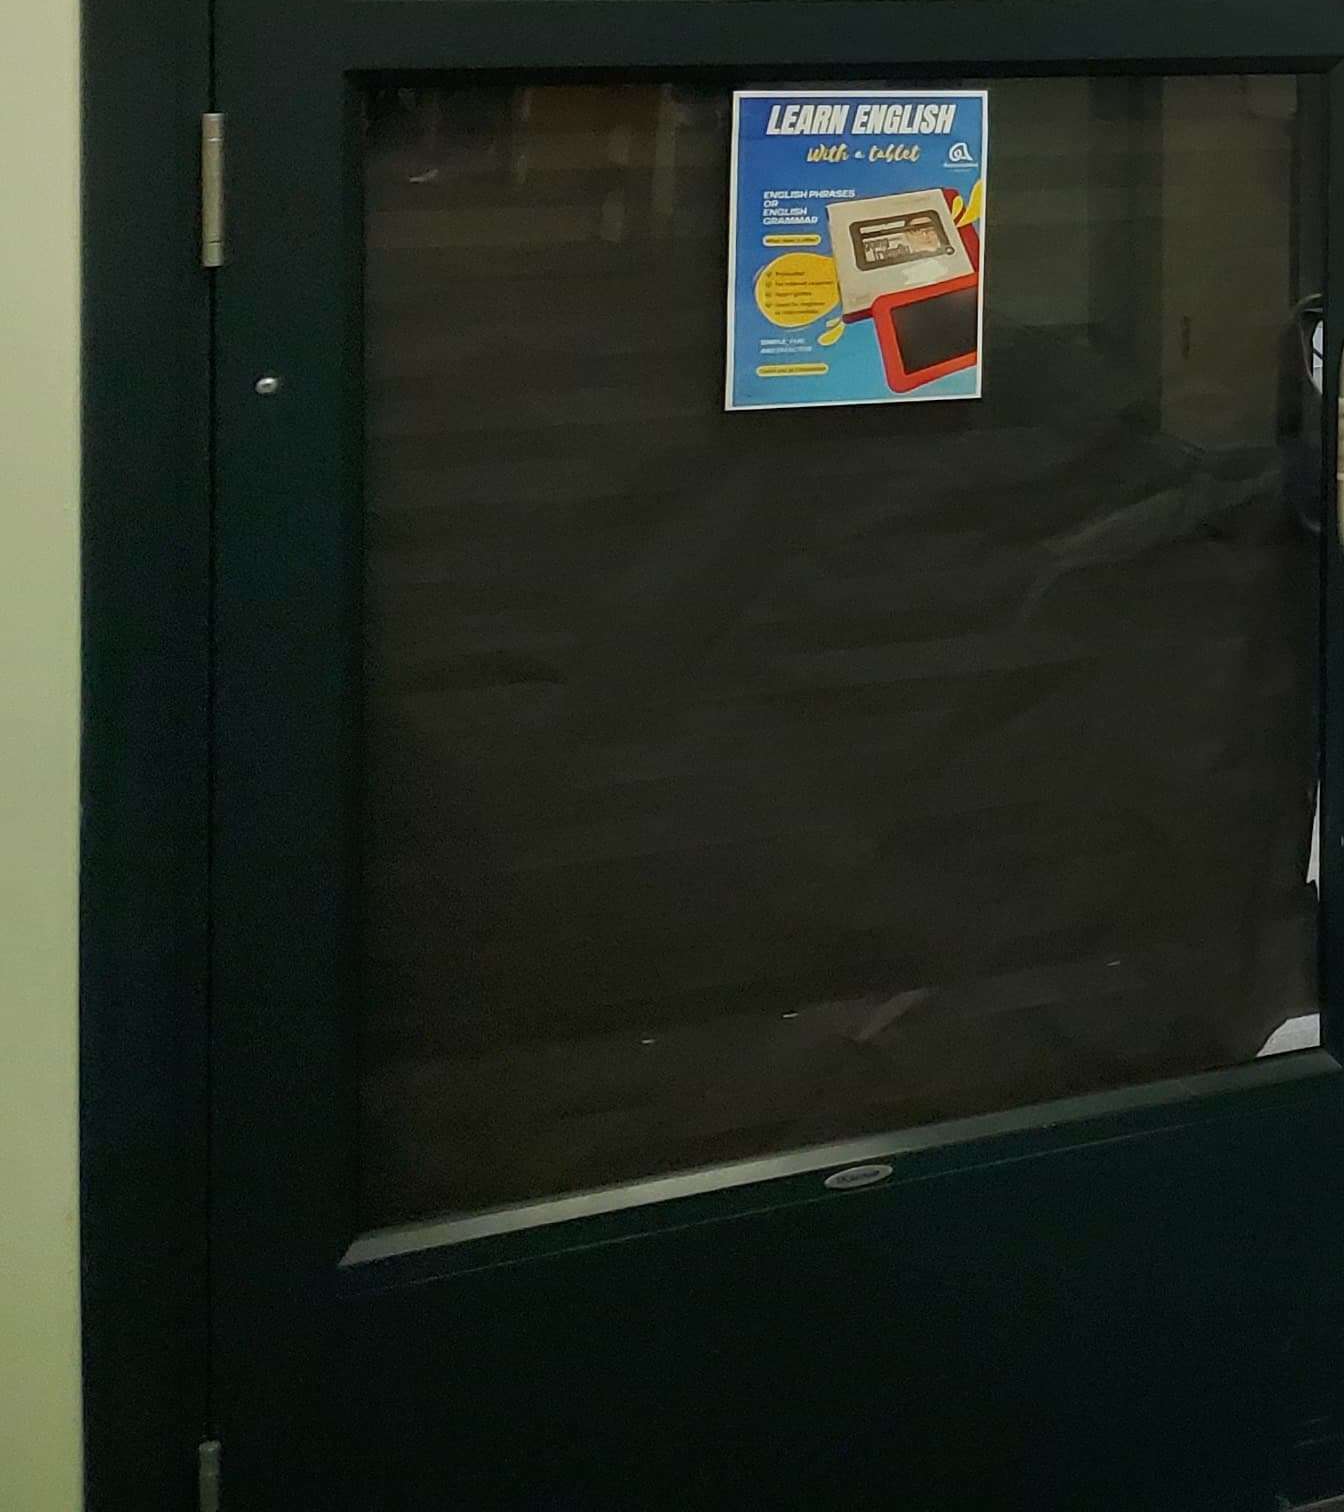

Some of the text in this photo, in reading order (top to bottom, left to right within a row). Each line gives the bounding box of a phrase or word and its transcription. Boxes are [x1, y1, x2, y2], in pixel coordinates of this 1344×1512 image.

[766, 104, 957, 136] LEARN ENGLISH
[868, 143, 921, 163] tablet
[763, 189, 856, 199] ENGLISH PHRASES
[763, 199, 779, 208] OR
[763, 207, 808, 216] ENGLISH
